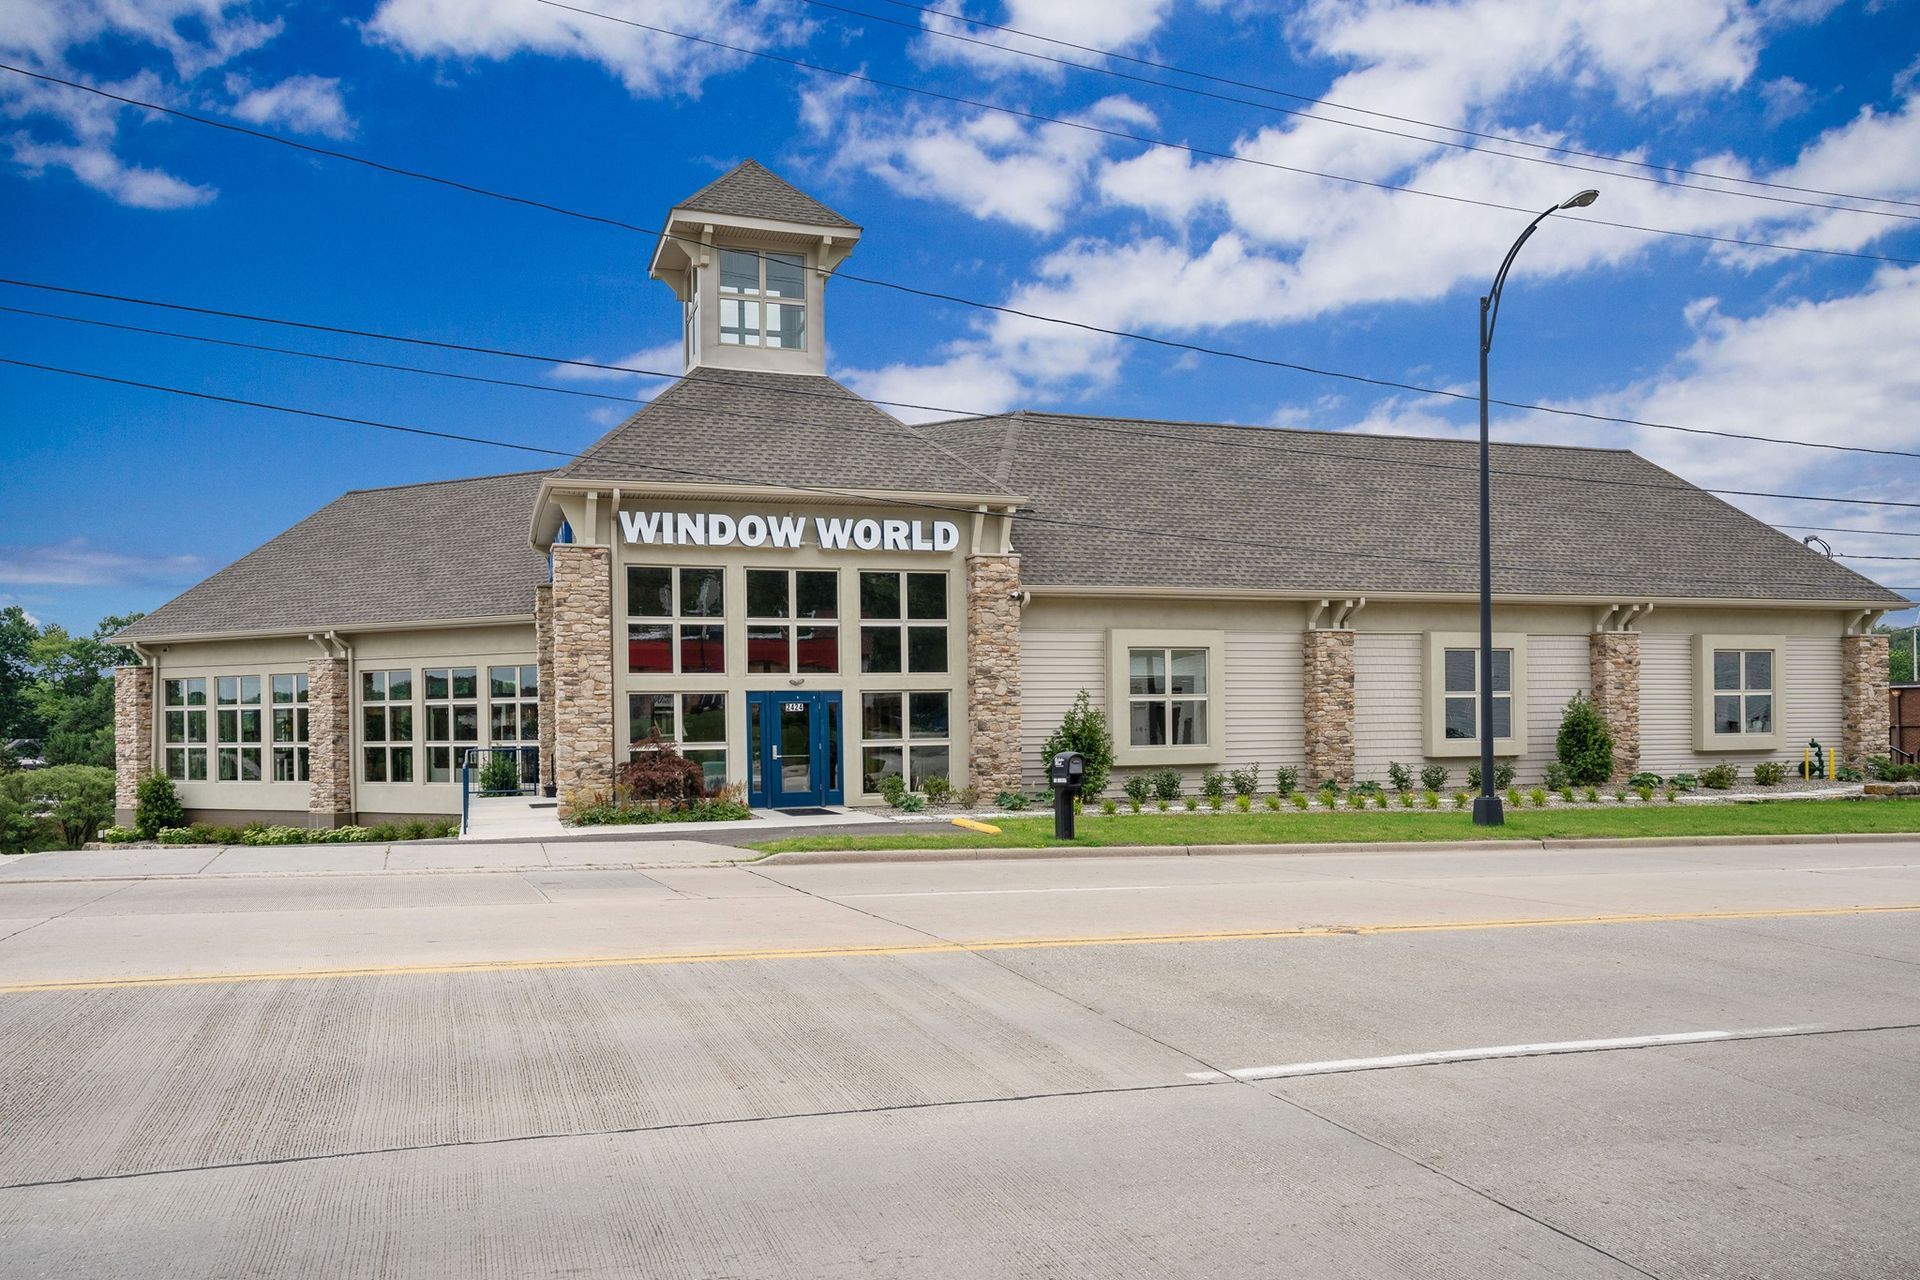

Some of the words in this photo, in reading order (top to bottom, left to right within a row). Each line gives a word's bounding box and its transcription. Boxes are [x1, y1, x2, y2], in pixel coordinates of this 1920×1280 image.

[618, 510, 806, 548] WINDOW
[815, 517, 960, 551] WORLD
[786, 703, 803, 711] 2424
